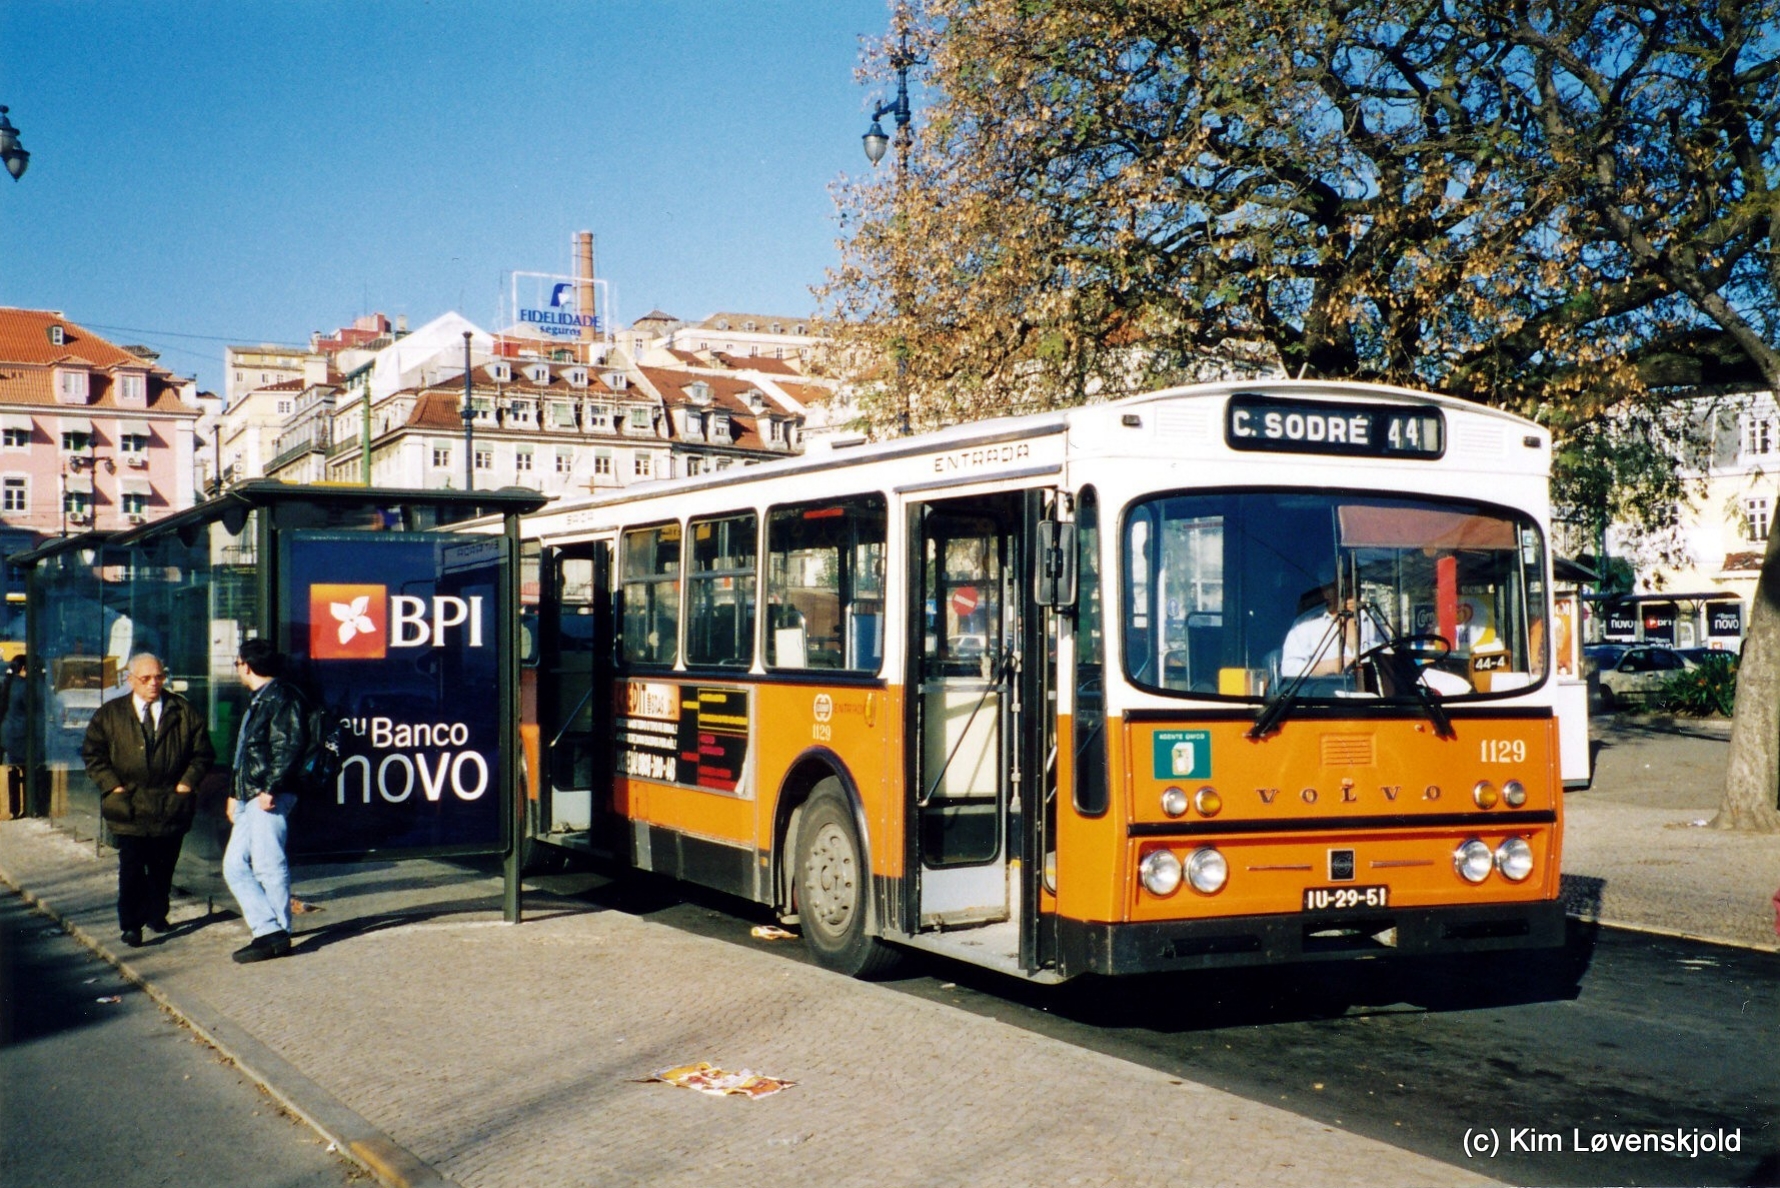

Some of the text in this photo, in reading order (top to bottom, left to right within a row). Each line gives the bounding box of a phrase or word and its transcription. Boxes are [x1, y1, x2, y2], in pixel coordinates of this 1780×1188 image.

[520, 309, 602, 328] FIDELIDADE
[540, 325, 581, 336] seguros
[1233, 410, 1419, 449] C. SODRÉ 44
[934, 444, 1029, 472] ENTRADA
[390, 595, 483, 647] BPI
[1714, 619, 1739, 630] novo
[1475, 656, 1505, 670] 44-4
[371, 717, 469, 748] Banco
[812, 724, 832, 741] 1129
[1481, 739, 1526, 763] 1129
[337, 751, 488, 804] novo
[1255, 785, 1442, 805] VOLVO
